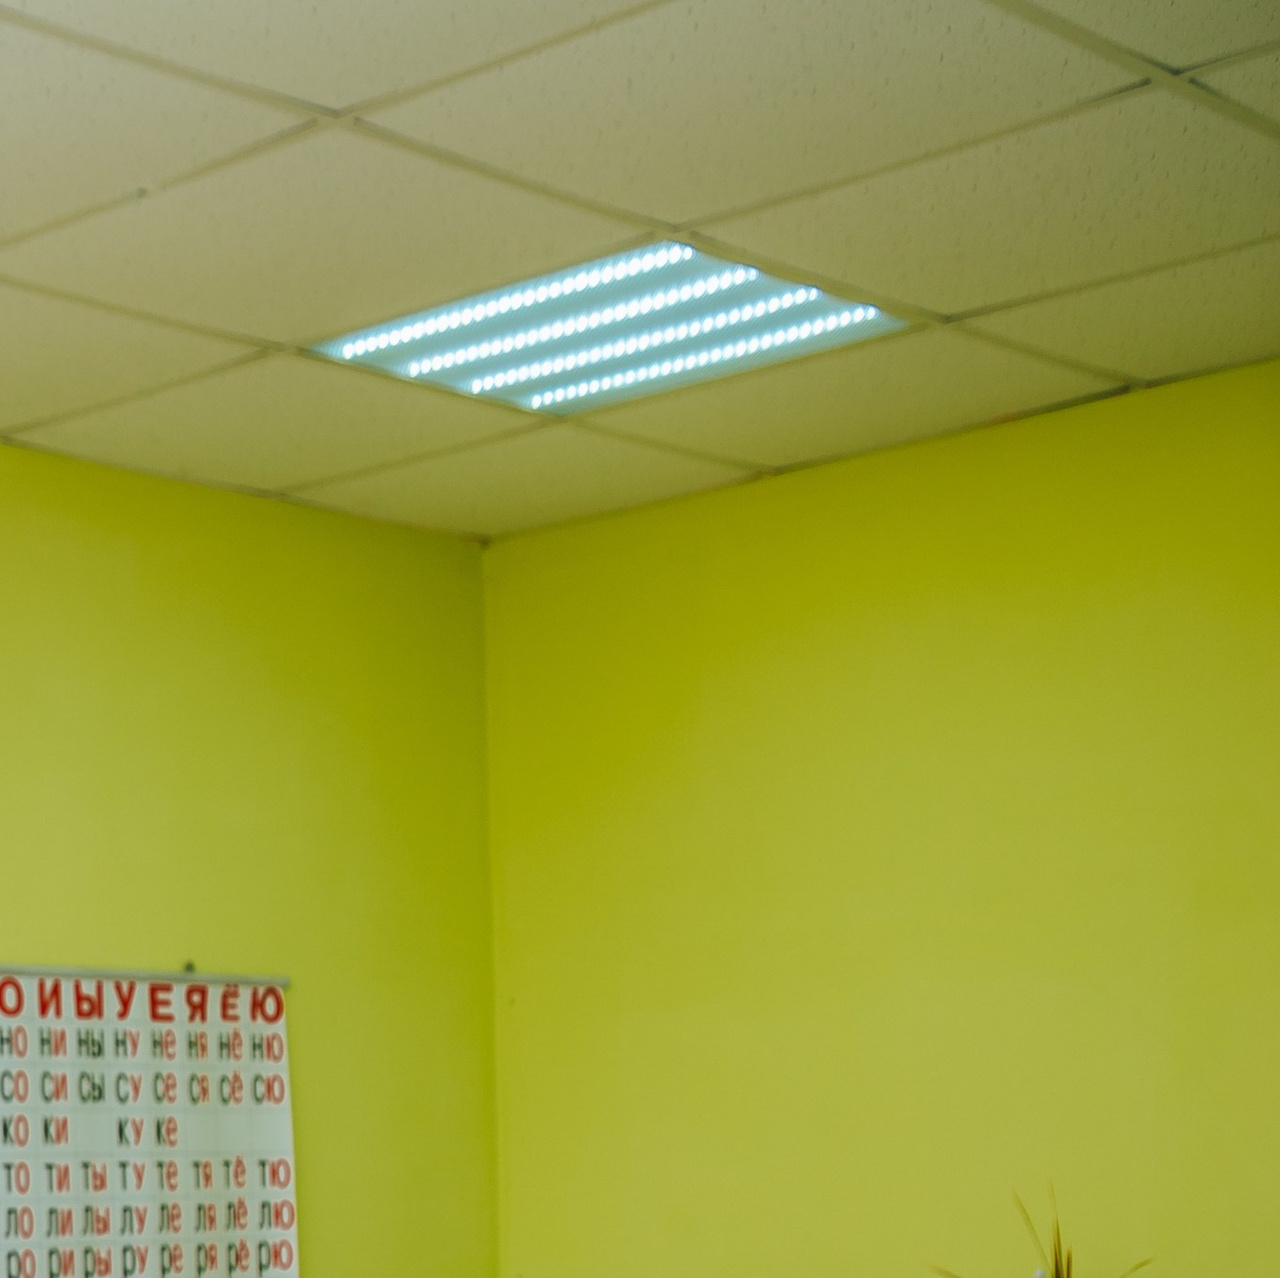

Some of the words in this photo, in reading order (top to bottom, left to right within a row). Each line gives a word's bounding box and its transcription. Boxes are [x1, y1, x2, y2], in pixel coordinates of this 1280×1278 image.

[38, 977, 62, 1019] И
[73, 978, 104, 1020] Ы
[114, 979, 136, 1020] У
[148, 982, 175, 1022] Е
[186, 984, 209, 1024] Я
[221, 983, 240, 1021] Ё
[250, 986, 284, 1024] Ю
[40, 1027, 67, 1057] ни
[77, 1028, 104, 1057] ны
[115, 1029, 140, 1059] ну
[152, 1029, 176, 1061] не
[251, 1032, 284, 1063] ню
[0, 1069, 29, 1104] со
[41, 1071, 67, 1103] си
[79, 1071, 105, 1103] сы
[116, 1072, 142, 1104] су
[154, 1072, 177, 1104] се
[254, 1073, 285, 1105] сю
[3, 1114, 29, 1148] ко
[43, 1115, 68, 1146] ки
[118, 1117, 144, 1146] ку
[156, 1116, 177, 1148] ке
[4, 1161, 30, 1195] то
[45, 1163, 70, 1194] ти
[82, 1161, 107, 1193] ты
[119, 1160, 145, 1191] ту
[157, 1160, 178, 1192] те
[259, 1158, 291, 1190] тю
[5, 1207, 34, 1239] ло
[47, 1208, 72, 1237] ли
[83, 1205, 110, 1236] лы
[121, 1206, 147, 1235] лу
[159, 1203, 182, 1234] ле
[259, 1199, 295, 1231] лю
